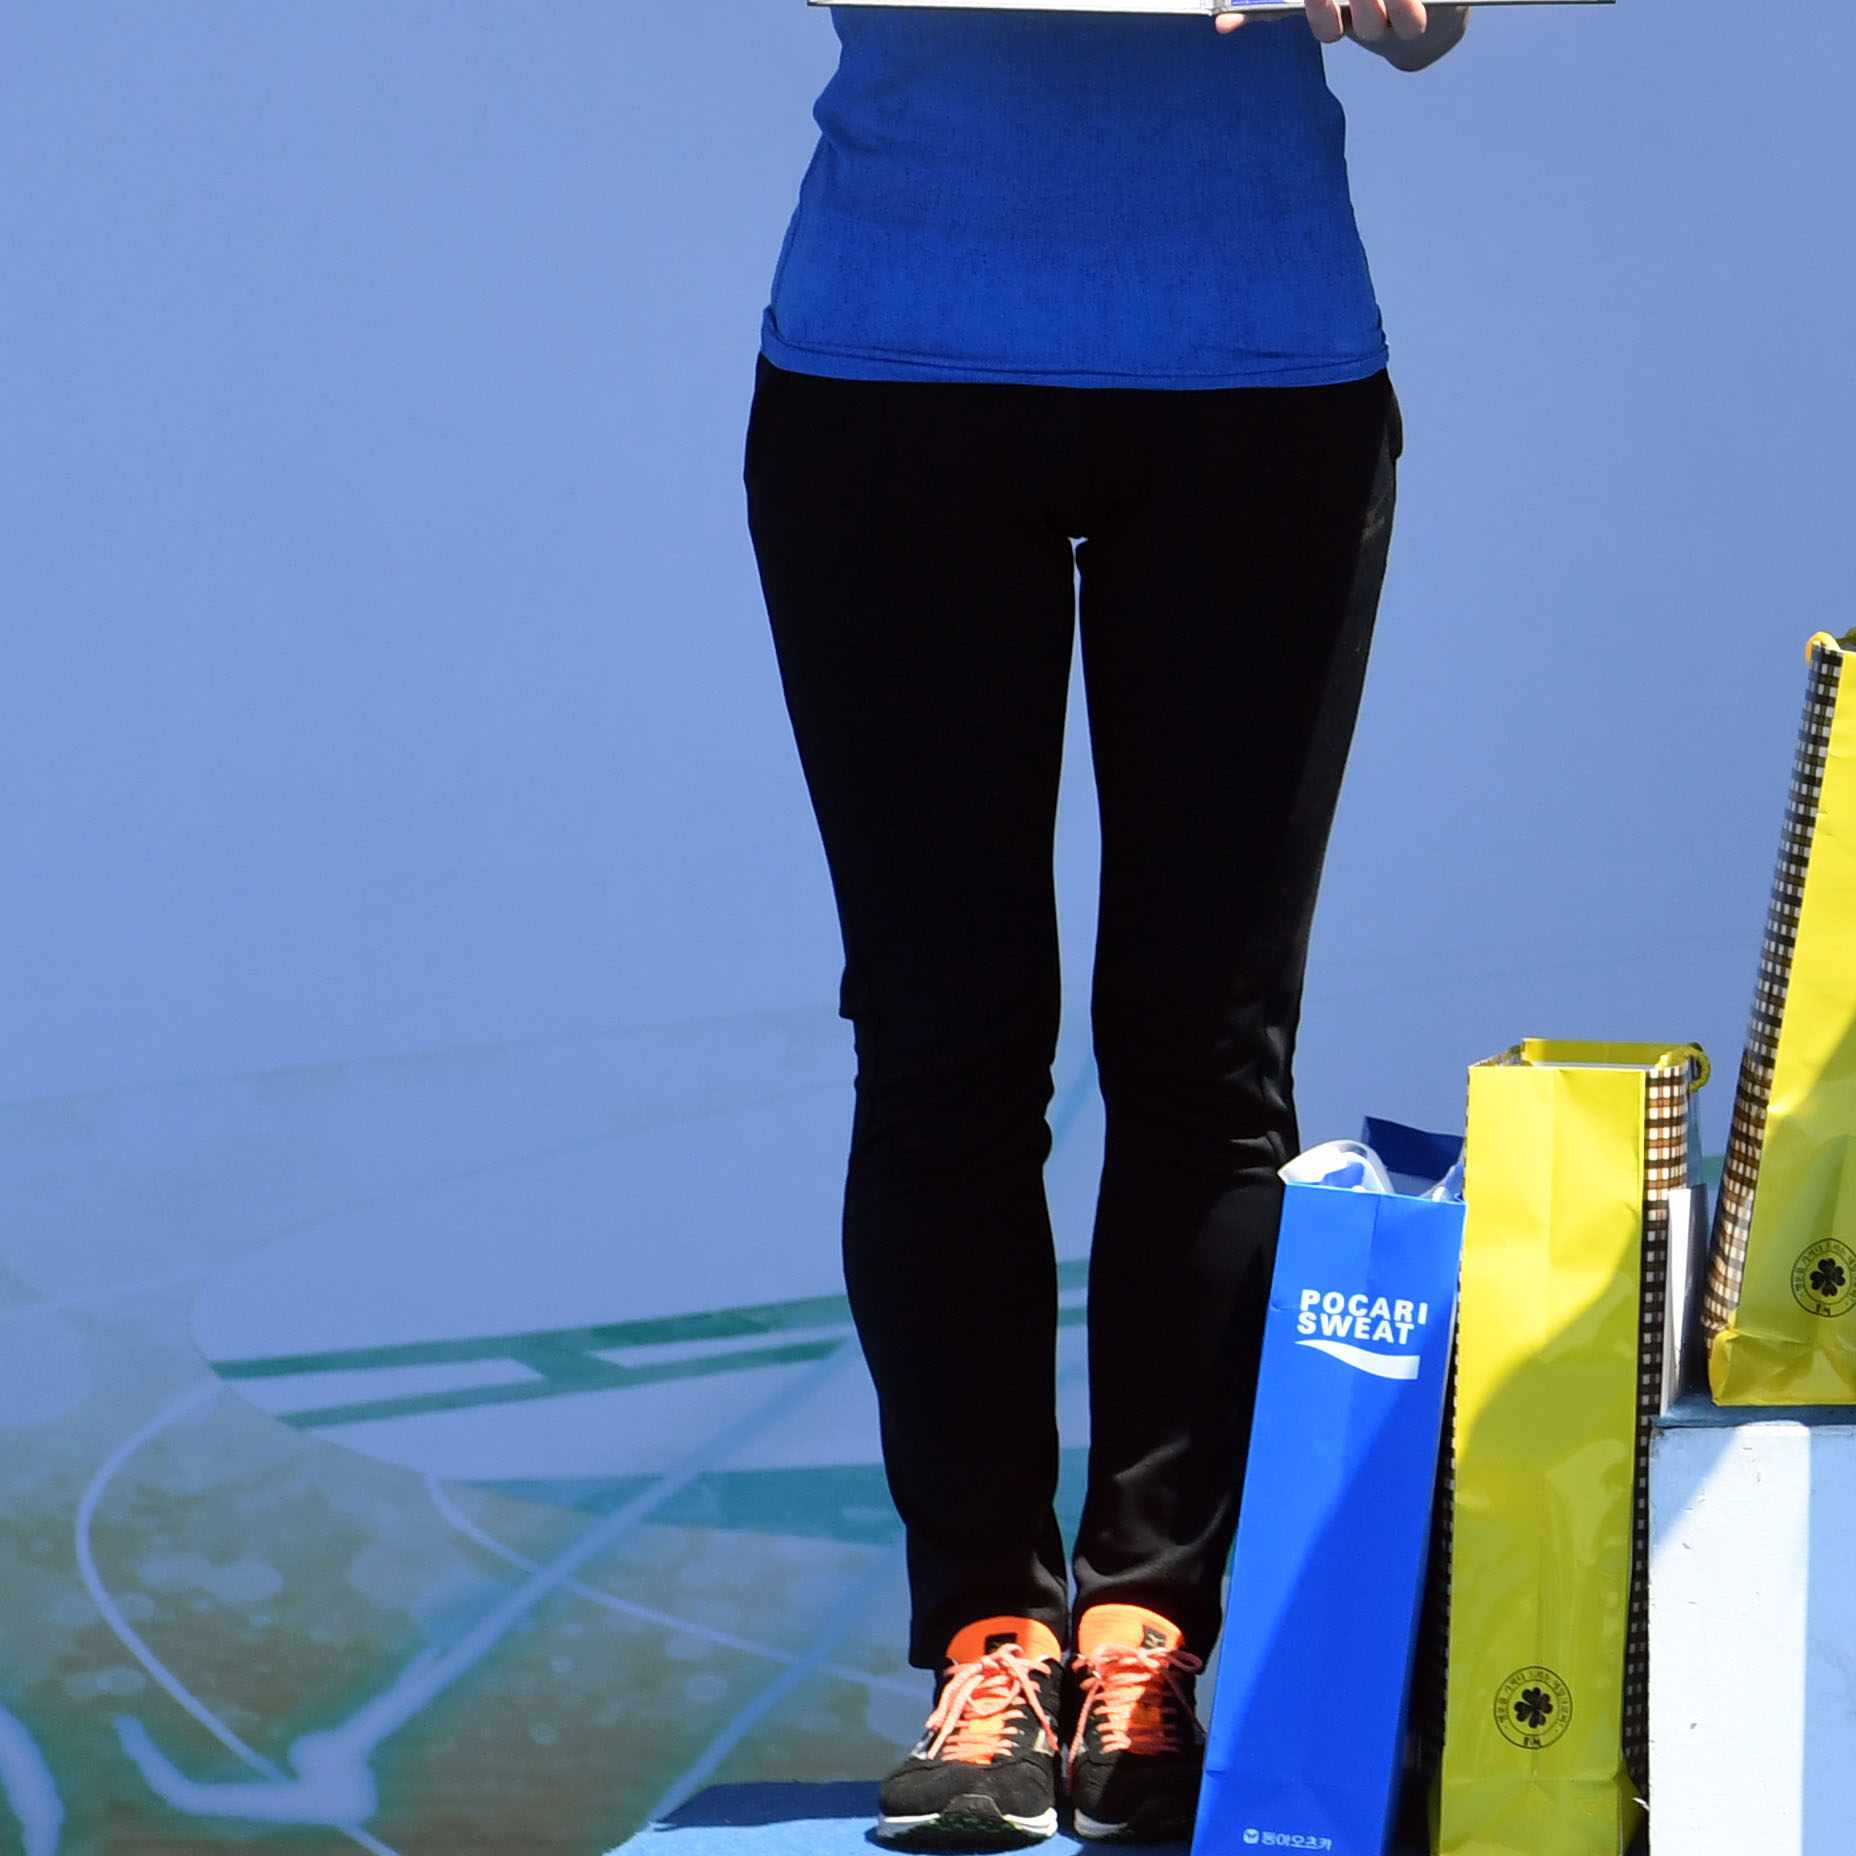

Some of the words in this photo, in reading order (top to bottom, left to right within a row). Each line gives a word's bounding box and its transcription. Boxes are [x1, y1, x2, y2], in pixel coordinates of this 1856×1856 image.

[1300, 1288, 1429, 1325] POCARI
[1297, 1311, 1415, 1345] SWEAT
[1261, 1831, 1333, 1852] 동아오츠카
